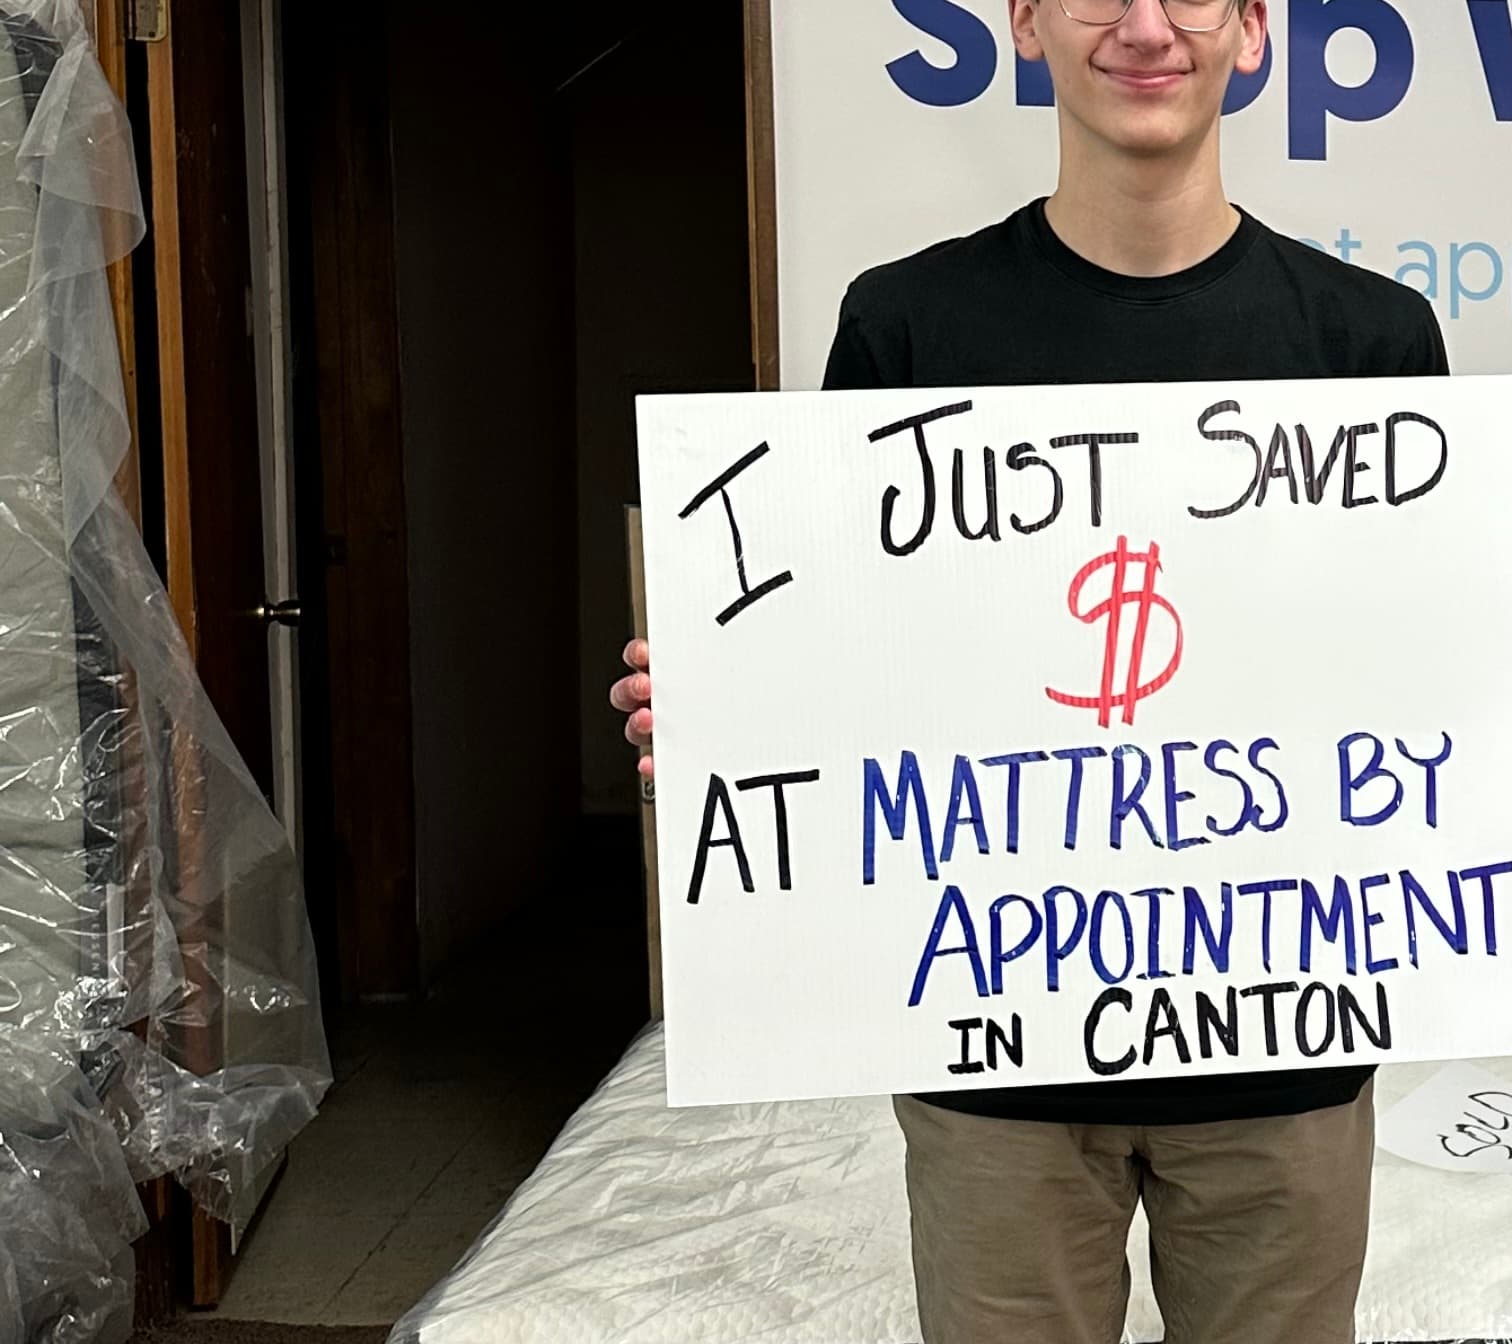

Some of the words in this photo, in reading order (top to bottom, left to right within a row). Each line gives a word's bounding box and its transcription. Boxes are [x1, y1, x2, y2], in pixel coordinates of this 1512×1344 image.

[678, 440, 794, 627] I
[867, 400, 1139, 557] JUST
[1187, 400, 1448, 519] SAVED
[1045, 535, 1183, 729] $
[686, 769, 820, 905] AT
[863, 737, 1289, 885] MATTRESS
[1337, 731, 1452, 829] BY
[947, 1012, 1023, 1075] IN
[1084, 981, 1392, 1076] CANTON
